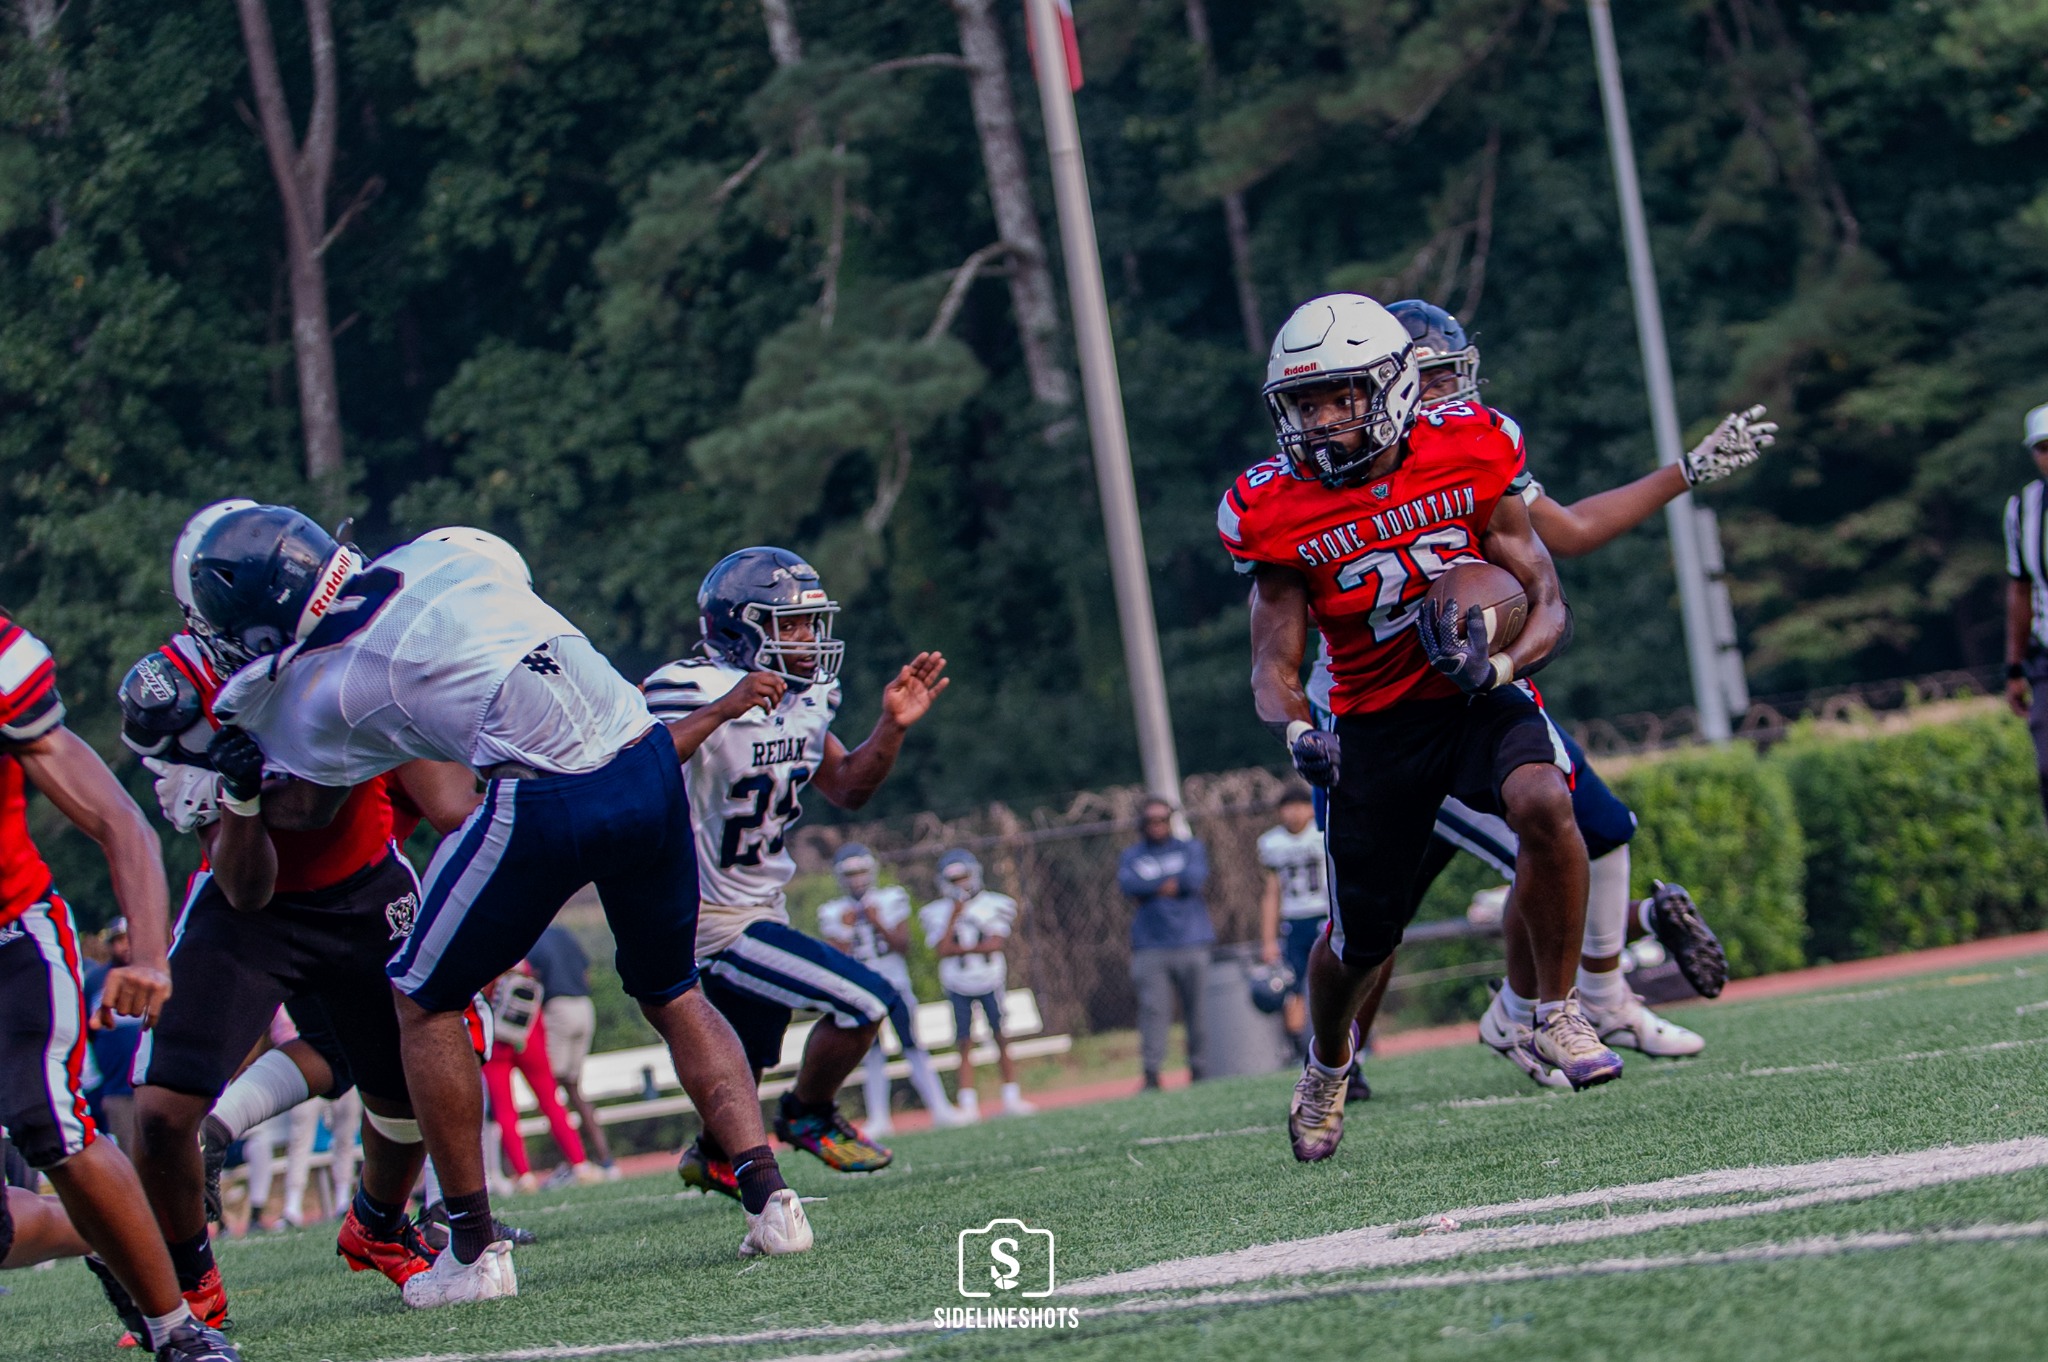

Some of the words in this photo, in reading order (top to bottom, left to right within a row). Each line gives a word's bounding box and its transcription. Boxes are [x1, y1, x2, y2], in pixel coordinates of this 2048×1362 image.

[1284, 362, 1317, 376] Riddell
[1297, 523, 1366, 567] STONE
[1371, 487, 1475, 540] MOUNTAIN
[309, 554, 353, 618] Riddell
[752, 737, 808, 767] REDAN
